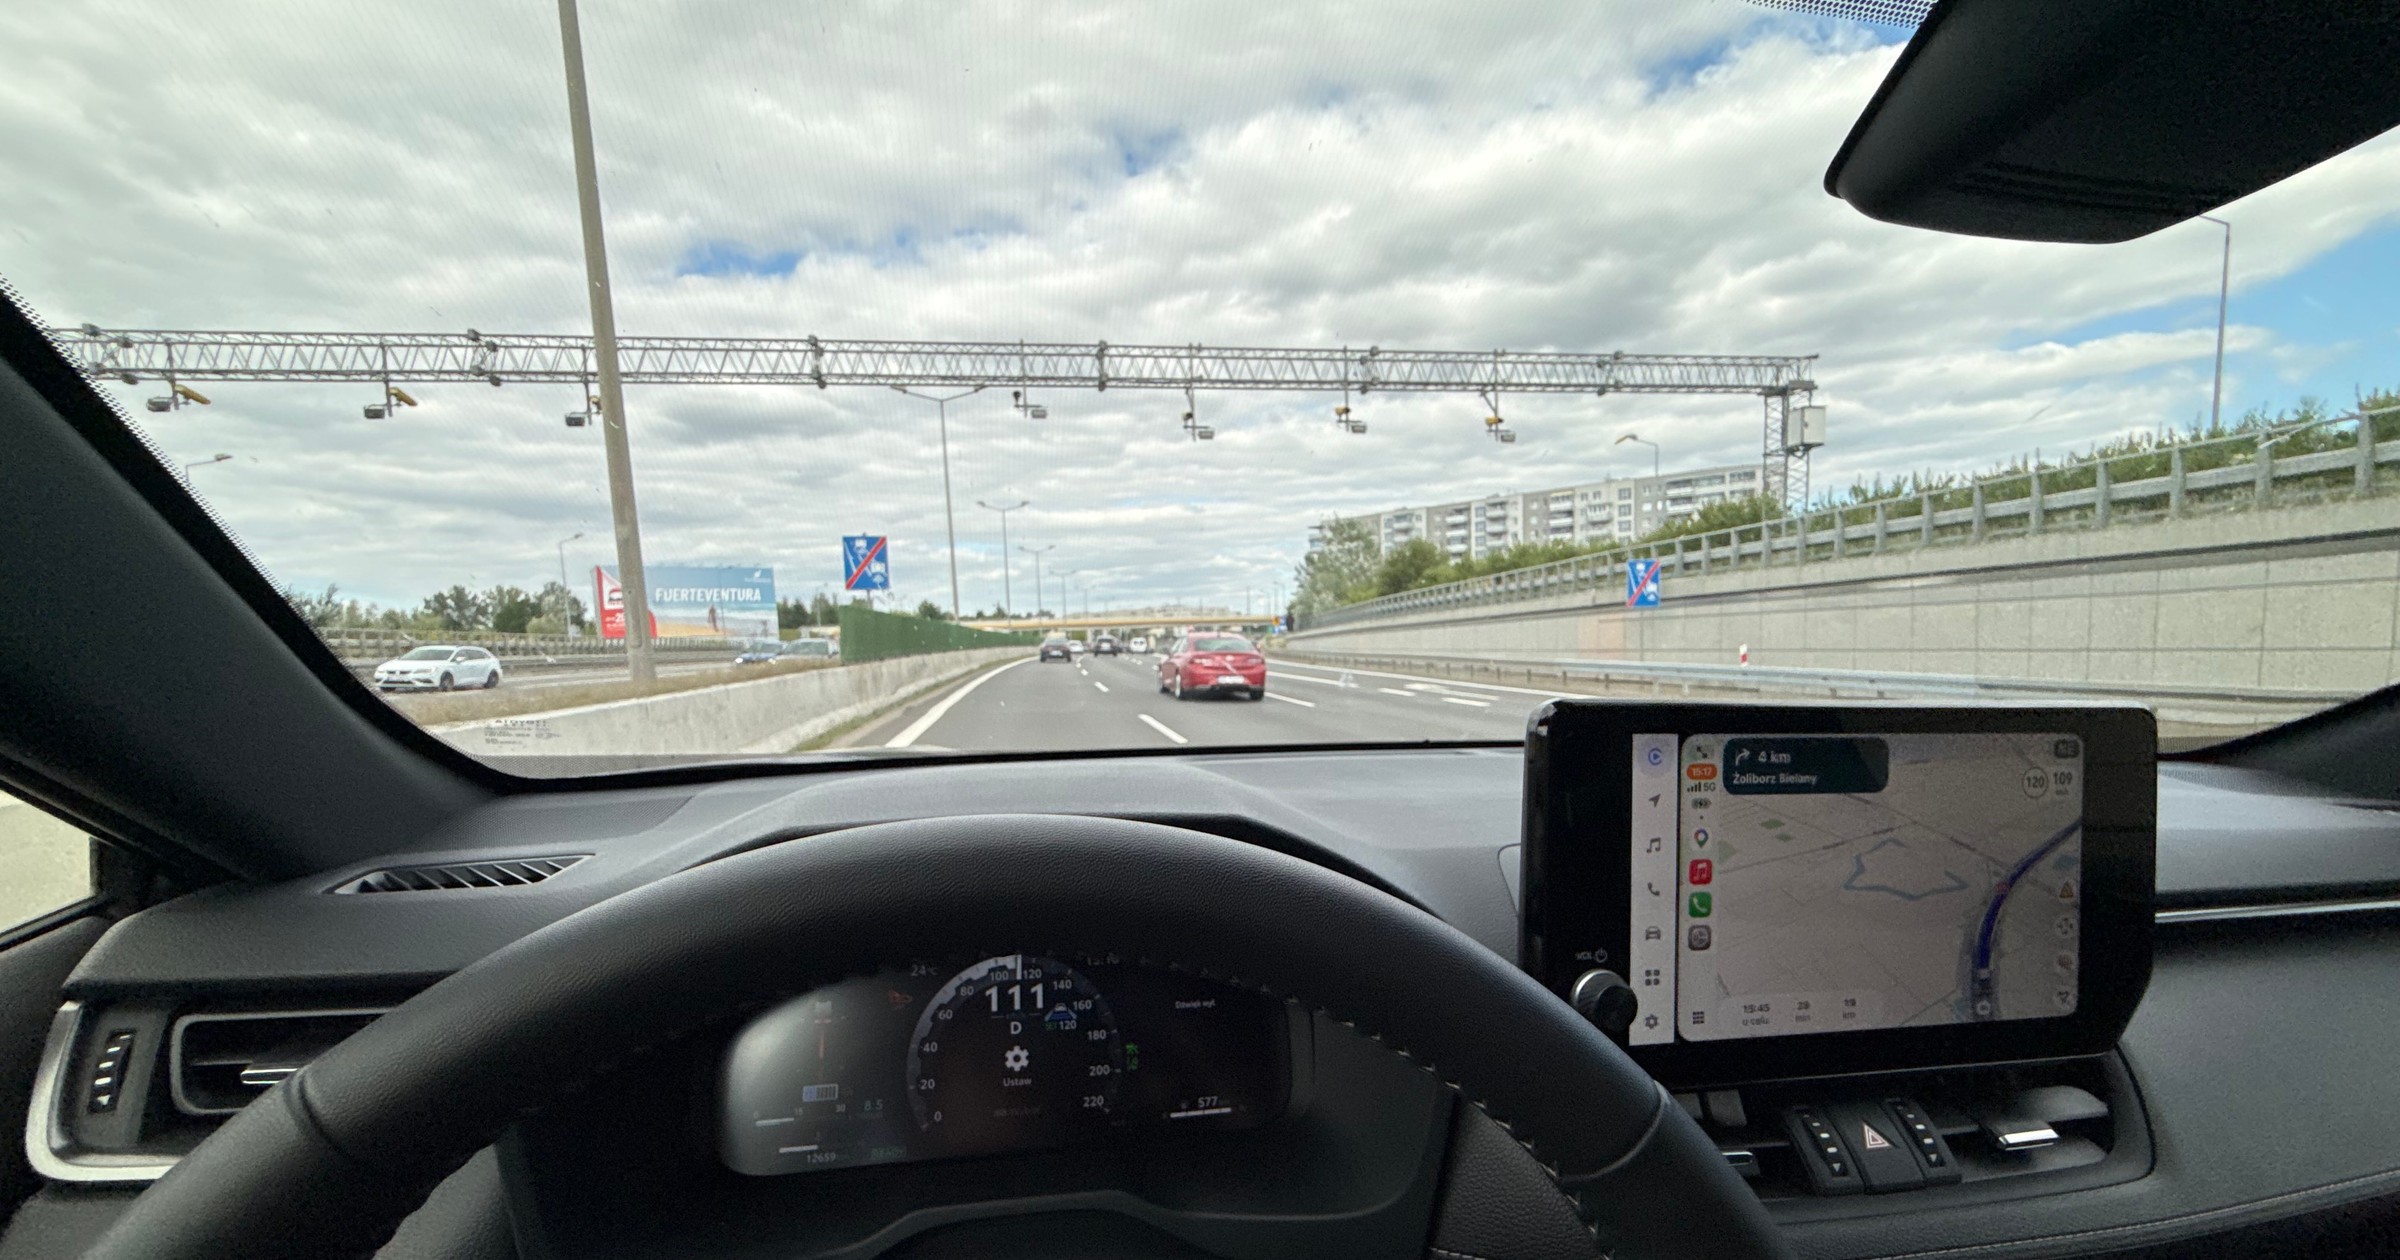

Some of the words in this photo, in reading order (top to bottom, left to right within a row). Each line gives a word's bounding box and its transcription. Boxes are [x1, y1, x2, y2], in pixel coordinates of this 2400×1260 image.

[654, 587, 762, 602] FUERTEVENTURA
[1757, 751, 1767, 763] 4
[1770, 750, 1791, 763] km
[1732, 771, 1776, 784] Żoliborz
[1779, 773, 1818, 785] Bielany
[2026, 776, 2045, 788] 120
[2054, 772, 2072, 785] 109
[1703, 782, 1716, 791] 5G
[989, 970, 1010, 981] 100
[1023, 968, 1042, 979] 120
[1053, 978, 1073, 990] 140
[960, 986, 974, 996] 80
[985, 983, 1044, 1012] 111
[1073, 1000, 1093, 1010] 160
[938, 1009, 953, 1020] 60
[1010, 1021, 1022, 1034] D
[1059, 1020, 1077, 1030] 120
[1088, 1029, 1107, 1040] 180
[923, 1042, 938, 1053] 40
[1089, 1065, 1110, 1076] 200
[920, 1078, 935, 1090] 20
[1003, 1077, 1032, 1087] Ustaw
[1083, 1095, 1104, 1108] 220
[1198, 1096, 1218, 1108] 577
[934, 1111, 942, 1121] 0
[806, 1152, 836, 1164] 12659
